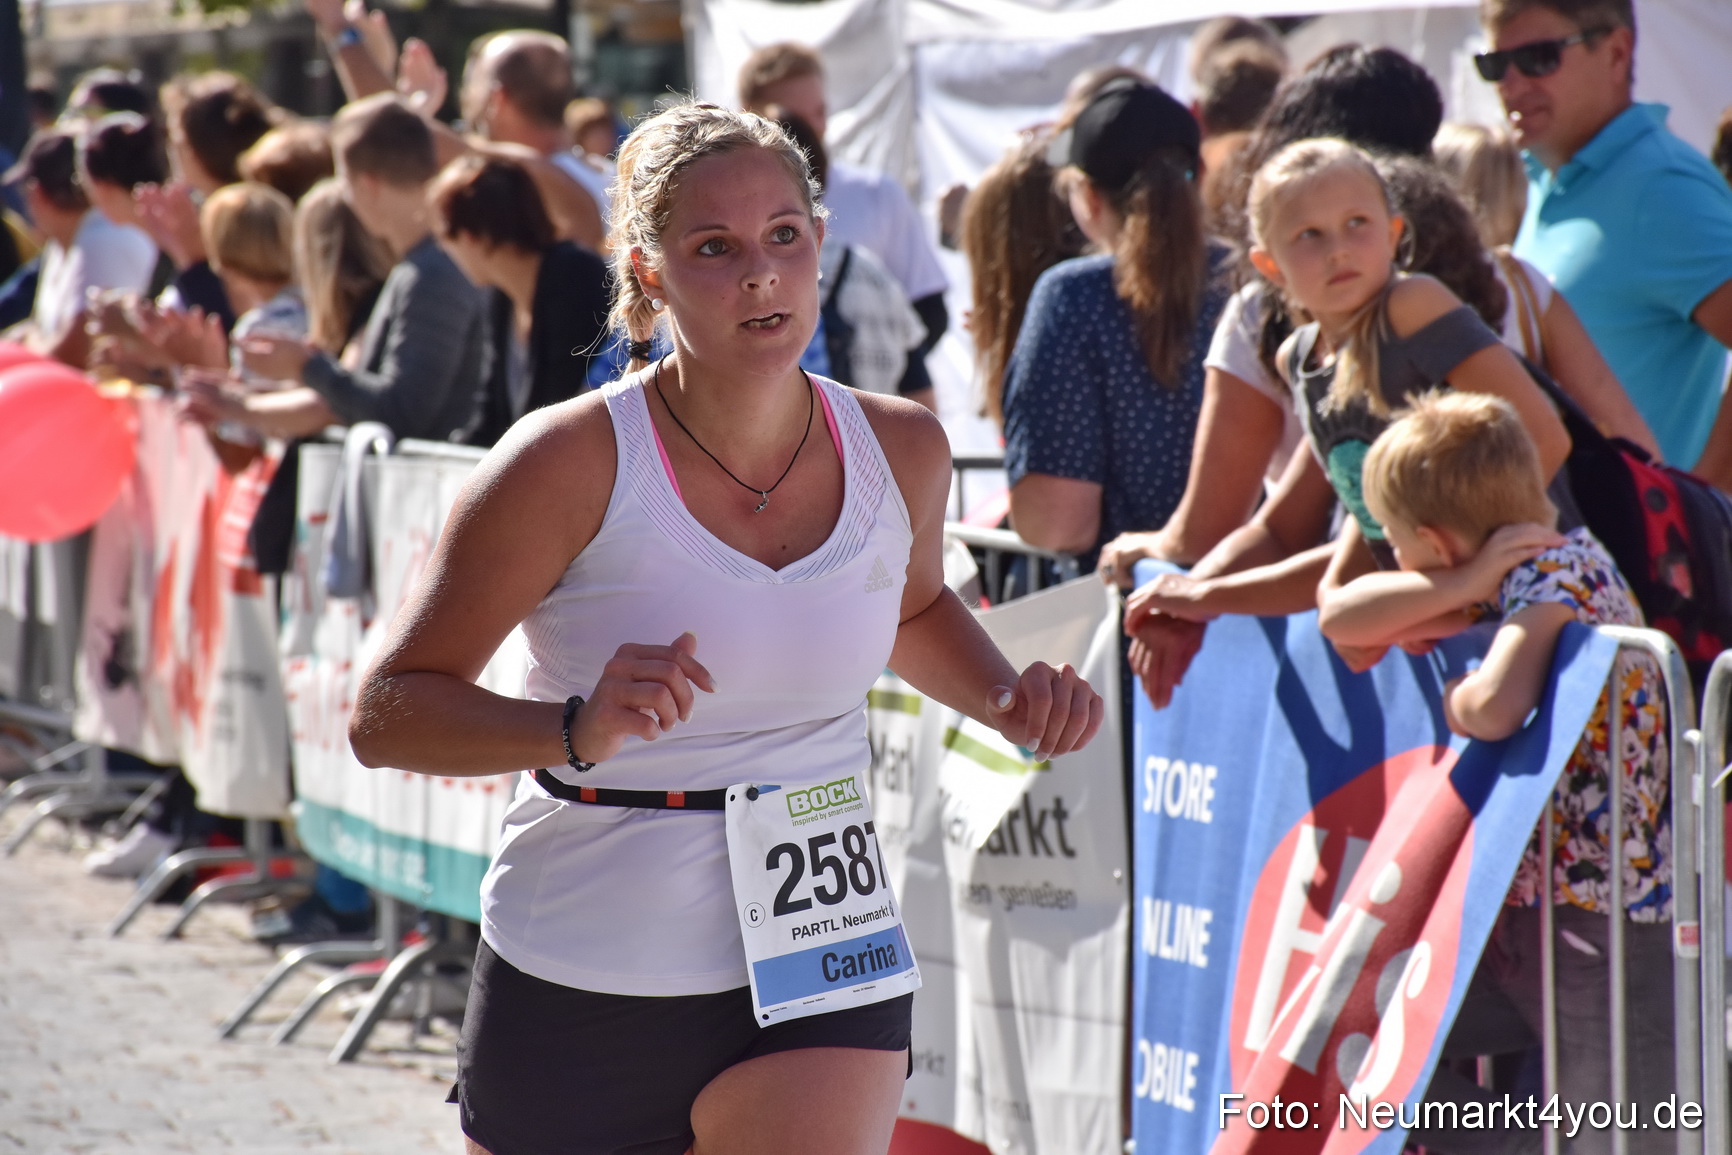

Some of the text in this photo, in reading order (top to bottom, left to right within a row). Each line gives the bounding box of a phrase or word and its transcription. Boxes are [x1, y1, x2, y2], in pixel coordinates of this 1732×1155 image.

[787, 777, 860, 816] BOCK
[1143, 755, 1218, 823] STORE
[792, 802, 864, 827] inspired by smart concepts
[766, 821, 887, 917] 2587
[750, 908, 759, 922] C
[792, 905, 889, 940] PARTL Neumarkt
[1142, 895, 1213, 968] NLINE
[821, 942, 898, 983] Carina
